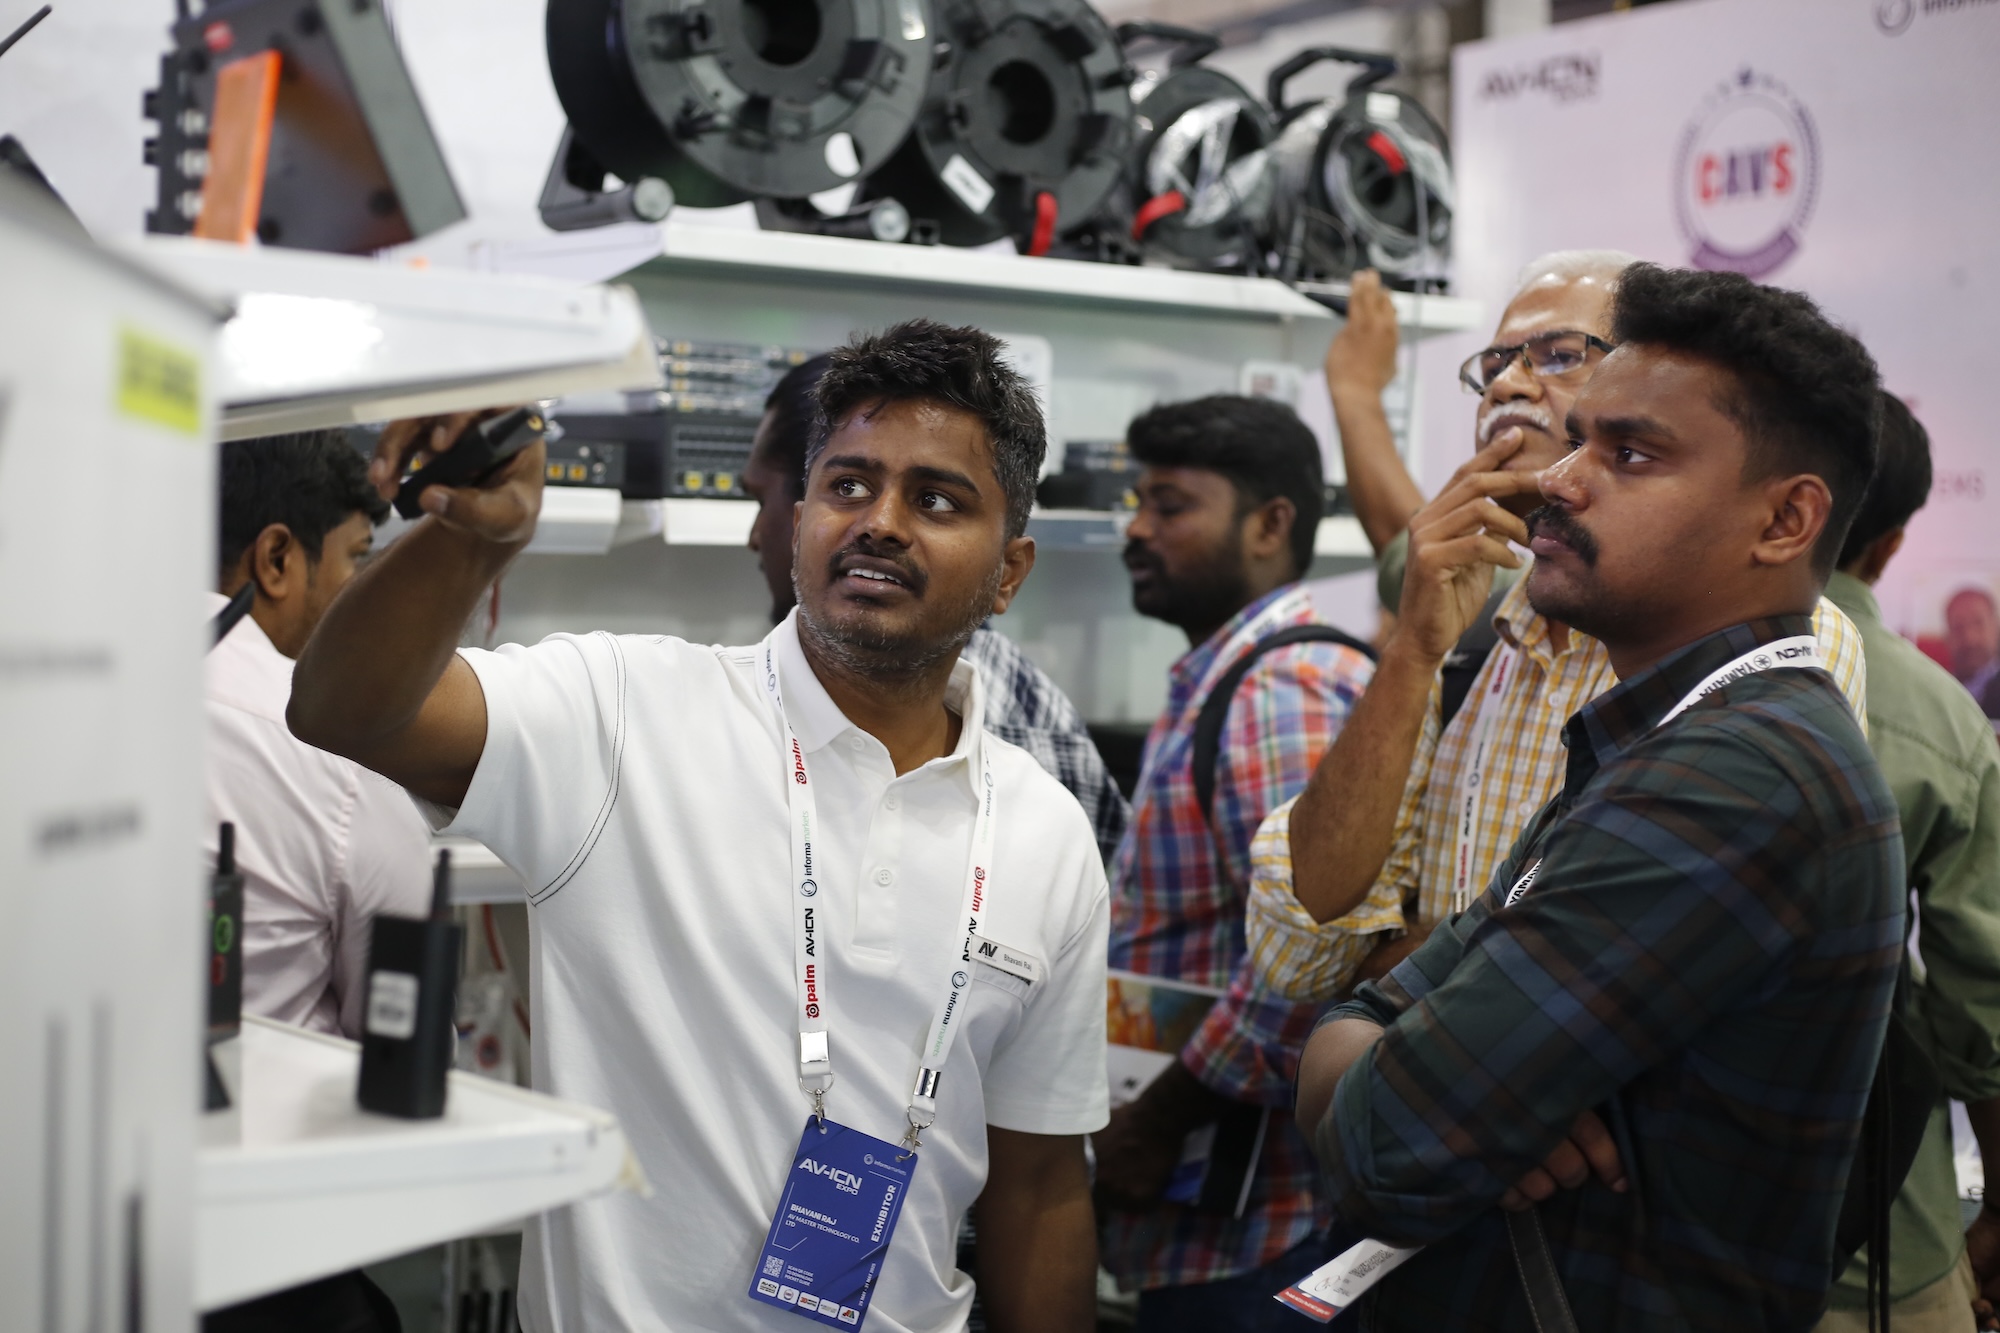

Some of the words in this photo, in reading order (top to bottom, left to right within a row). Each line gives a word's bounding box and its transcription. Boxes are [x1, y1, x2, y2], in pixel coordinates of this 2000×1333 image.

[1697, 143, 1795, 205] CAVS
[792, 738, 805, 771] palm
[971, 879, 983, 912] palm
[805, 908, 815, 957] AV-ICN
[978, 941, 998, 958] AV
[804, 964, 818, 1002] palm
[798, 1158, 862, 1190] AV-ICN
[835, 1183, 859, 1196] EXPO
[785, 1219, 796, 1228] LTD
[787, 1213, 796, 1221] AV
[795, 1216, 817, 1229] MASTER
[817, 1223, 852, 1240] TECHNOLOGY
[850, 1236, 860, 1244] CO.
[790, 1203, 821, 1220] BHAVANI
[820, 1214, 837, 1226] RAJ
[870, 1185, 897, 1243] EXHIBITOR
